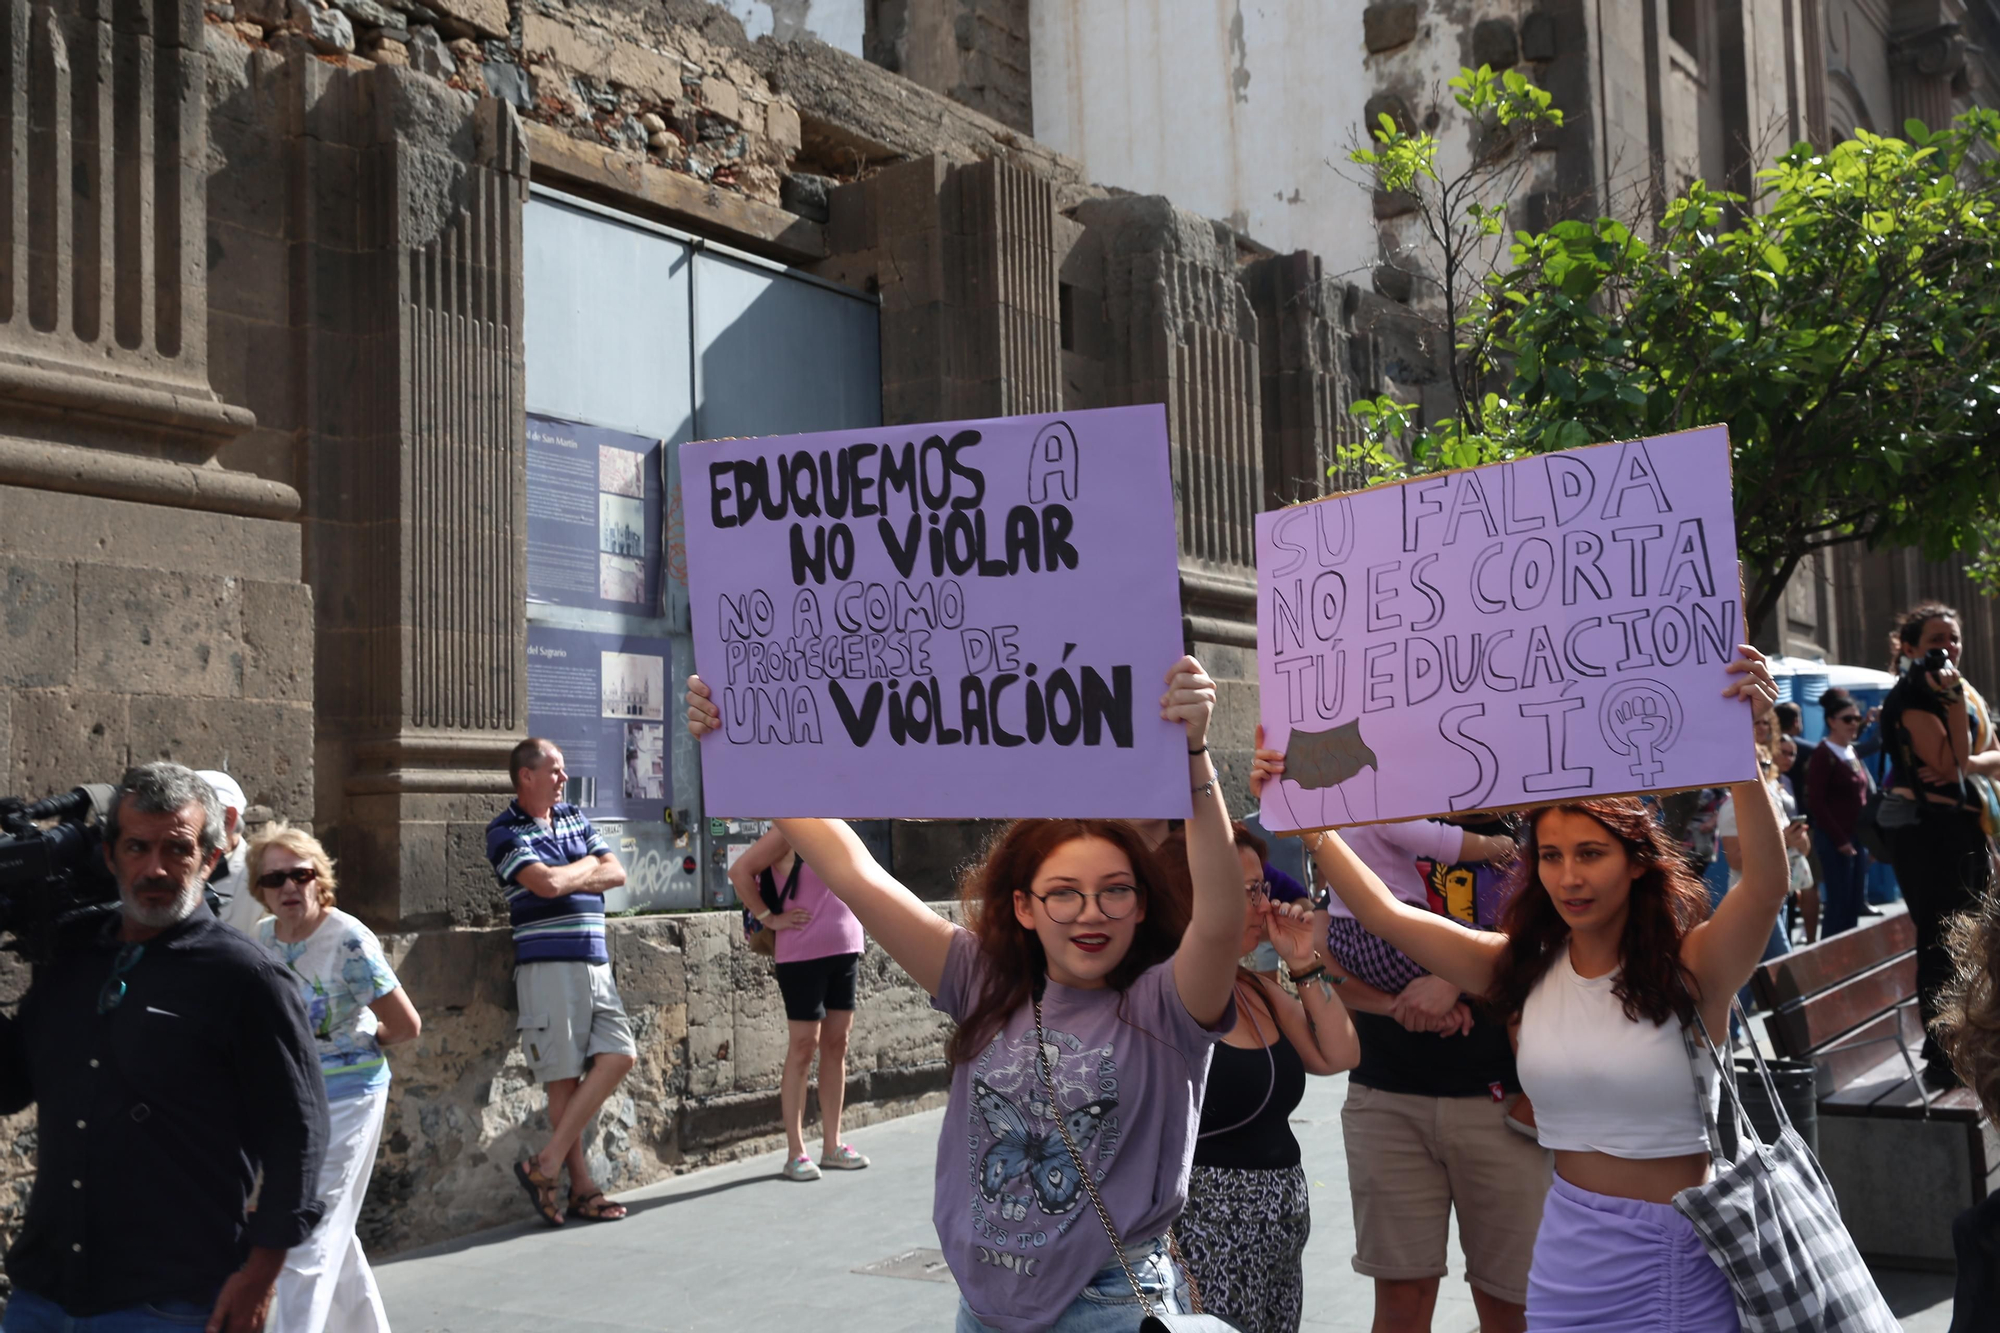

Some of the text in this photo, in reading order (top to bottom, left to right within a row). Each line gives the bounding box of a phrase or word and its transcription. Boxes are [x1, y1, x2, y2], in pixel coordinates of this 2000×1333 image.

[542, 433, 555, 444] San
[709, 421, 1078, 528] EDUQUEMOS A
[1272, 440, 1673, 578] SU FALDA
[790, 523, 855, 585] NO
[718, 579, 964, 643] NO A COMO
[1273, 518, 1716, 656] NO ES CORTA
[960, 625, 1020, 675] DE
[1274, 585, 1736, 724] TÚ EDUCACIÓN
[723, 685, 823, 745] UNA
[1439, 679, 1594, 812] SÍ
[1017, 1231, 1047, 1249] TO
